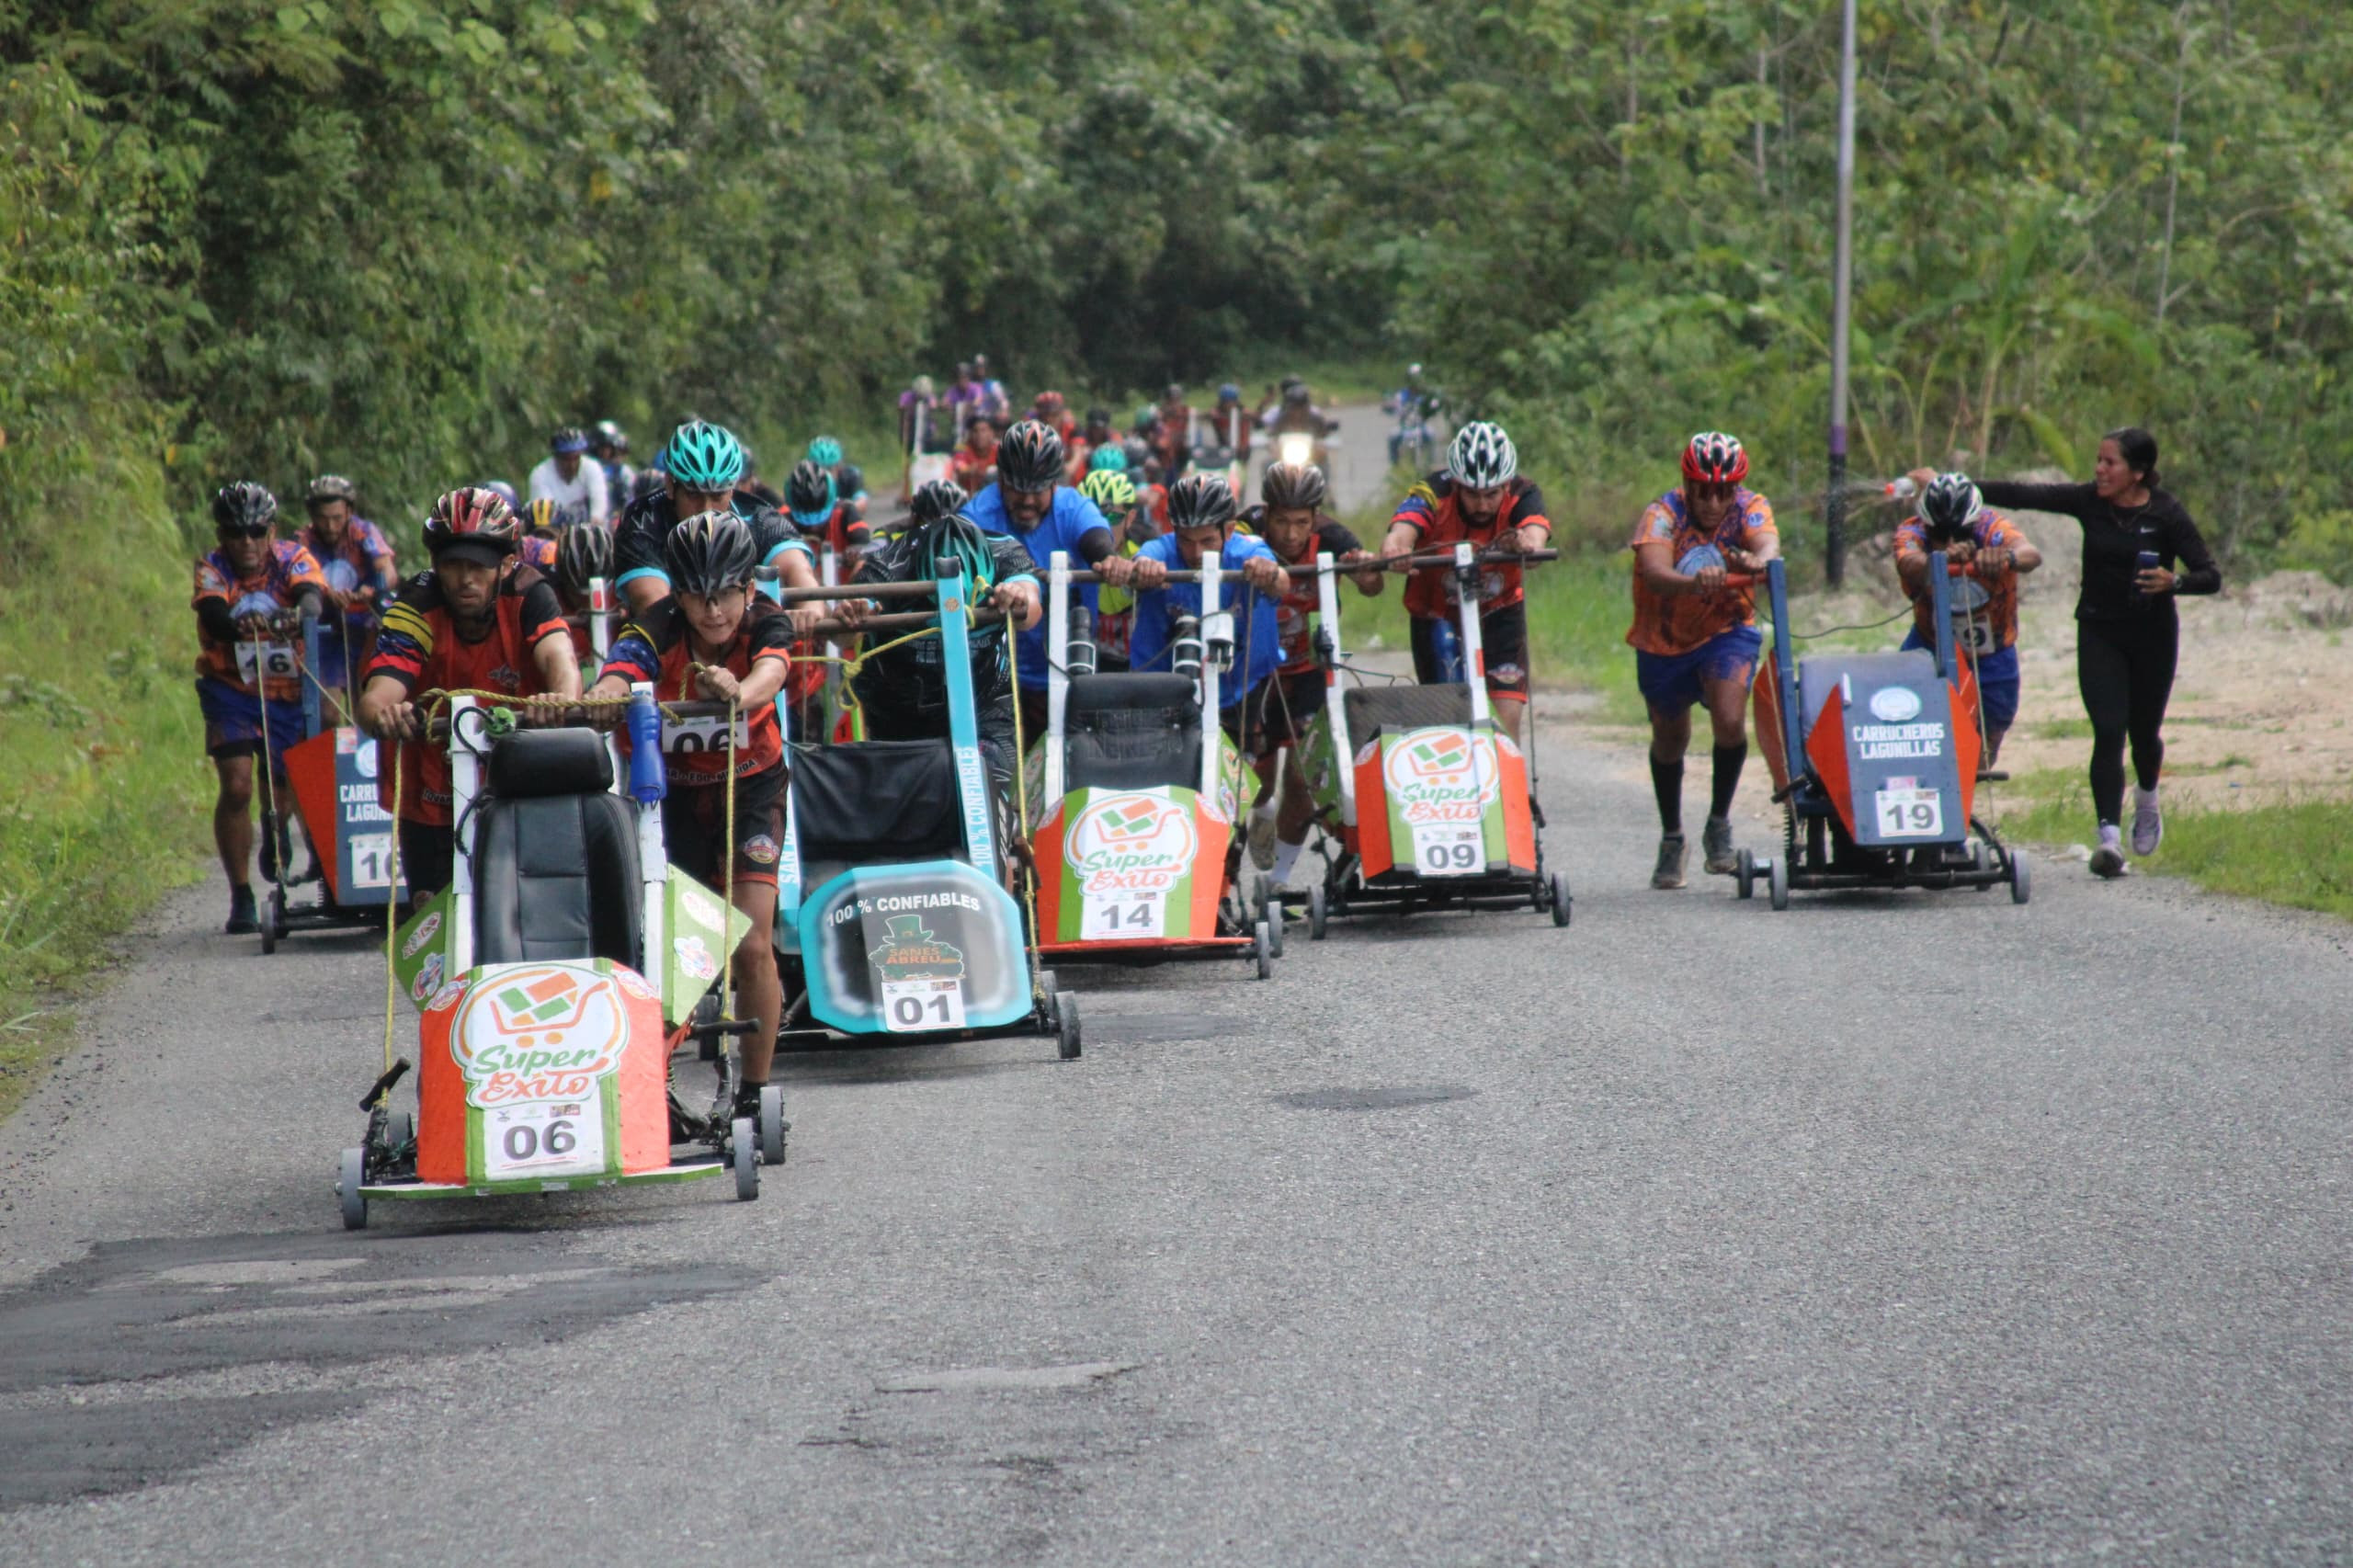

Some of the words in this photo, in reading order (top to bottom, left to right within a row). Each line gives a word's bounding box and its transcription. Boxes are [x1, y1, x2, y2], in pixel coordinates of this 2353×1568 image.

[1853, 722, 1945, 743] CARRUCHEROS
[1860, 740, 1941, 759] LAGUNILLAS
[1403, 783, 1480, 805] Super
[1887, 803, 1935, 830] 19
[1083, 850, 1173, 873] Super
[1427, 844, 1476, 869] 09
[826, 904, 853, 927] 100
[858, 899, 872, 914] %
[877, 892, 981, 912] CONFIABLES
[1101, 903, 1153, 929] 14
[886, 955, 941, 964] ABREU
[889, 947, 941, 957] SANES
[894, 994, 950, 1025] 01
[473, 1044, 596, 1077] Super
[503, 1119, 576, 1161] 06
